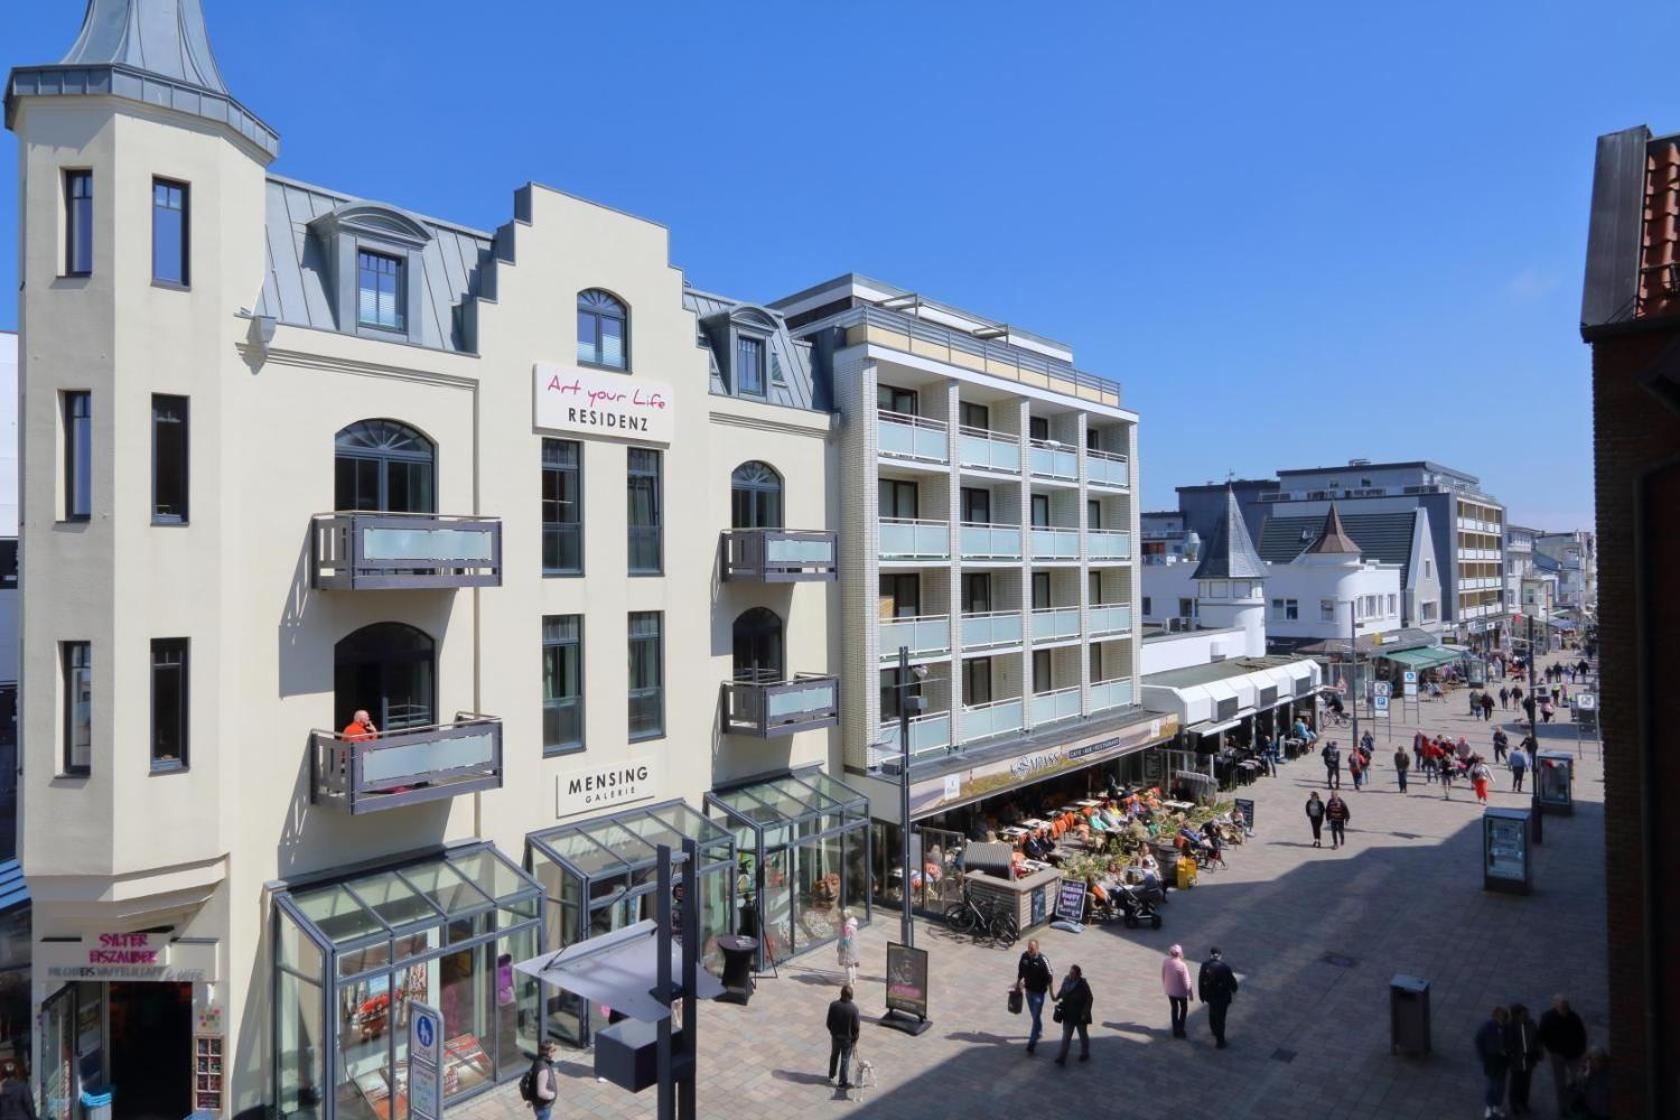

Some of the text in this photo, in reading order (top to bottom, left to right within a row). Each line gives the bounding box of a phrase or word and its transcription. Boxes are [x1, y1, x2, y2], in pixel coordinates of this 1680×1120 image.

[548, 375, 666, 409] Art your Life
[568, 407, 648, 431] RESIDENZ
[568, 766, 648, 795] MENSING
[585, 786, 635, 804] GALERIE
[99, 933, 148, 947] SYLTER
